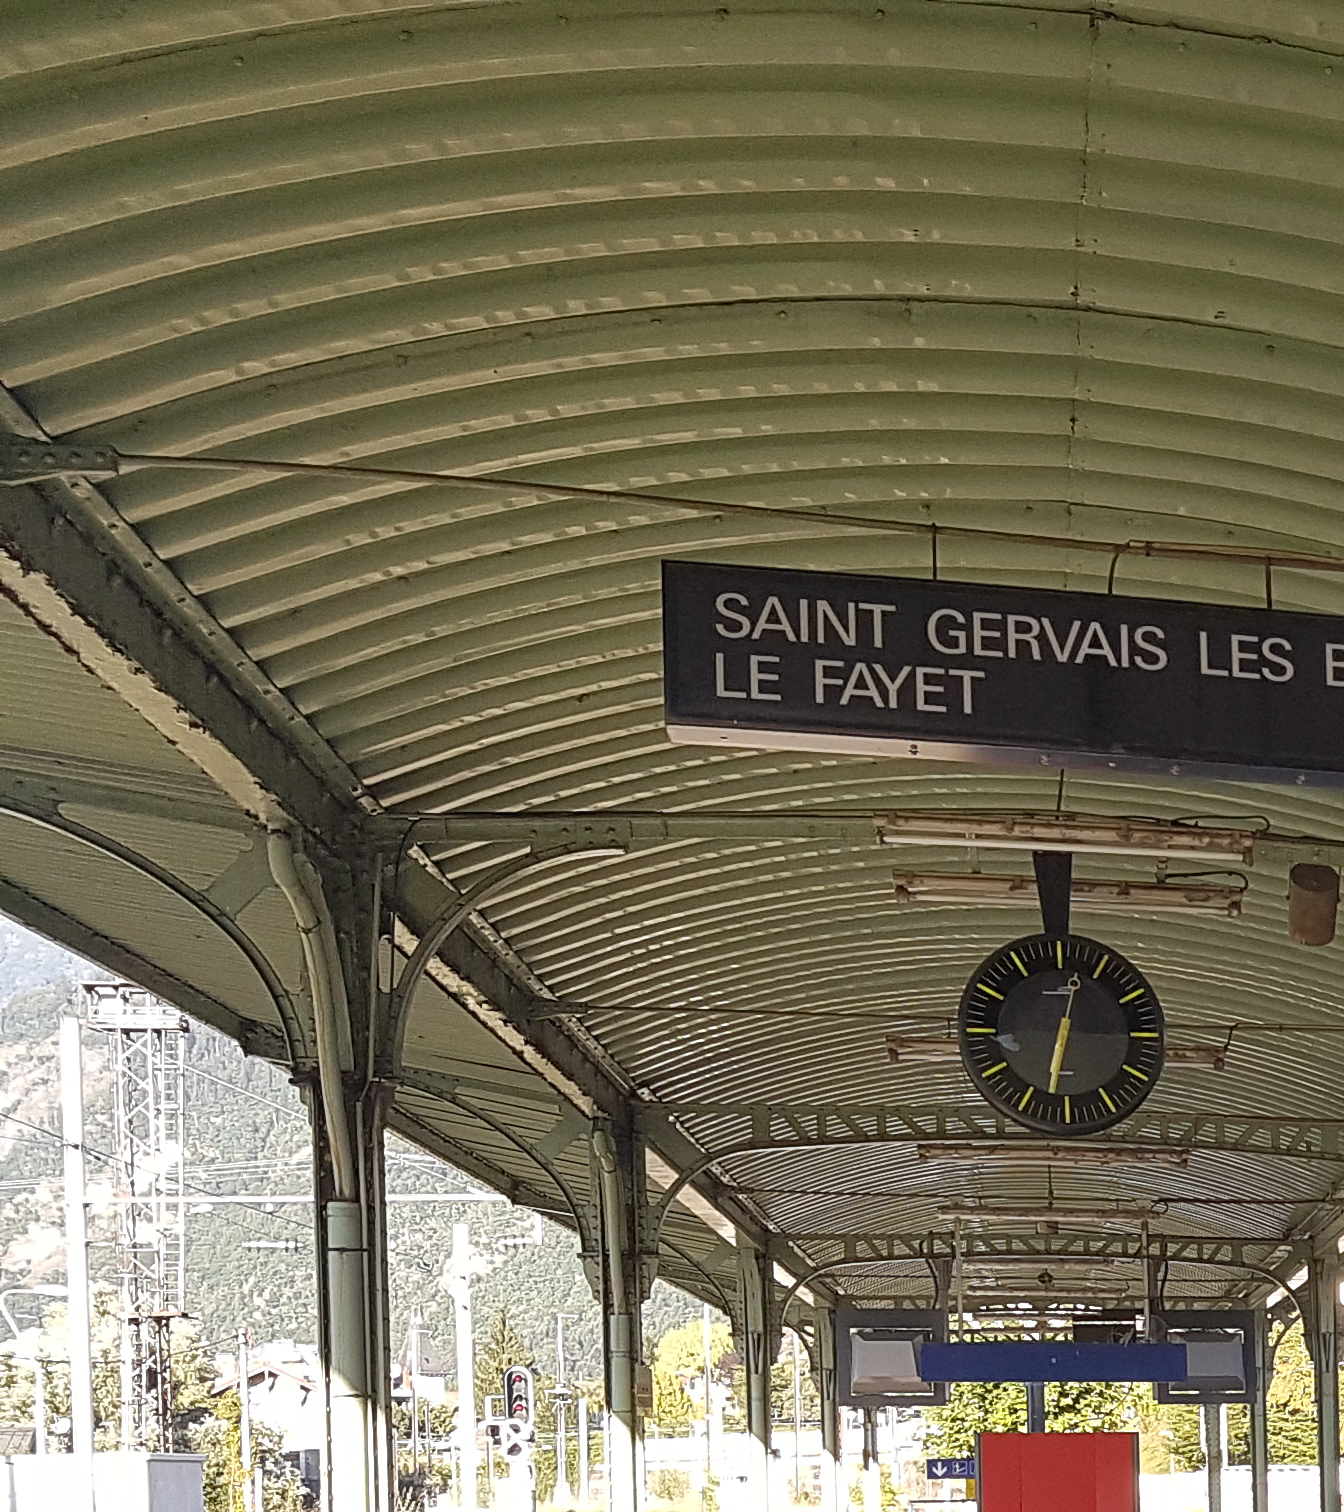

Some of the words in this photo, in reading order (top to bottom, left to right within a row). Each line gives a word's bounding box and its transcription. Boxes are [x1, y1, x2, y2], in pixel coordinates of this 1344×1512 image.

[715, 592, 897, 649] SAINT
[927, 608, 1169, 671] GERVAIS
[1199, 631, 1295, 683] LES
[715, 652, 782, 701] LE
[814, 659, 986, 715] FAYET
